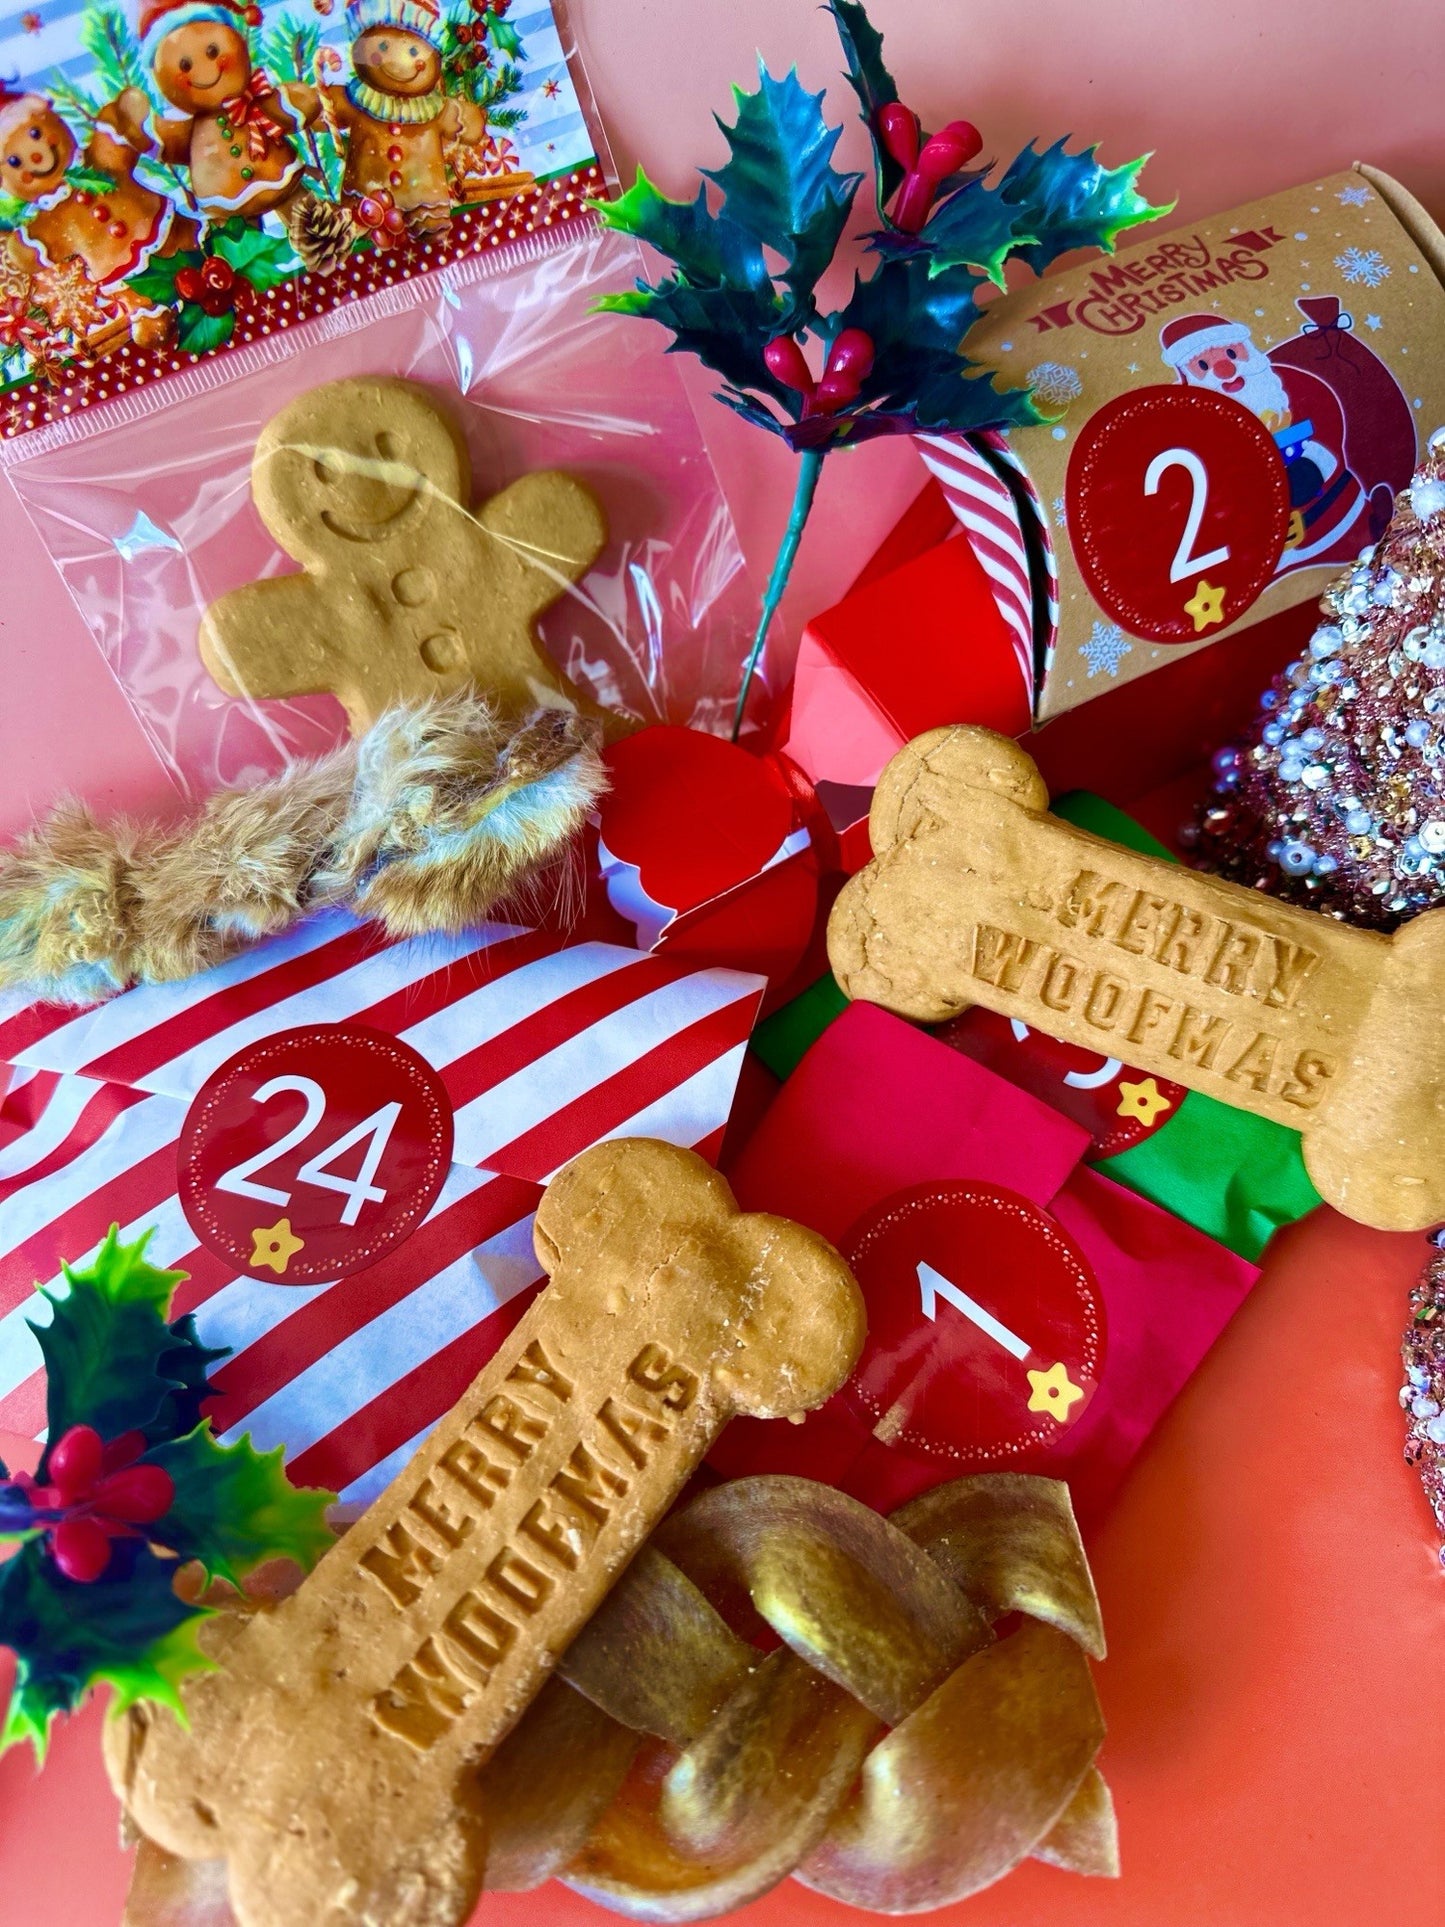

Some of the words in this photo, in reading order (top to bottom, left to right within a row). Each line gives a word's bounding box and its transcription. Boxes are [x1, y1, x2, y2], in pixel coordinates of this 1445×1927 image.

[1074, 249, 1270, 336] CHRISTMAS
[1089, 235, 1211, 297] MERRY
[1143, 447, 1230, 584] 2
[1056, 869, 1322, 1010] MERRY
[972, 922, 1340, 1110] WOOFMAS
[214, 1074, 403, 1226] 24
[915, 1260, 1032, 1362] 1
[357, 1338, 576, 1611] MERRY
[372, 1340, 700, 1752] WOOFMAS
